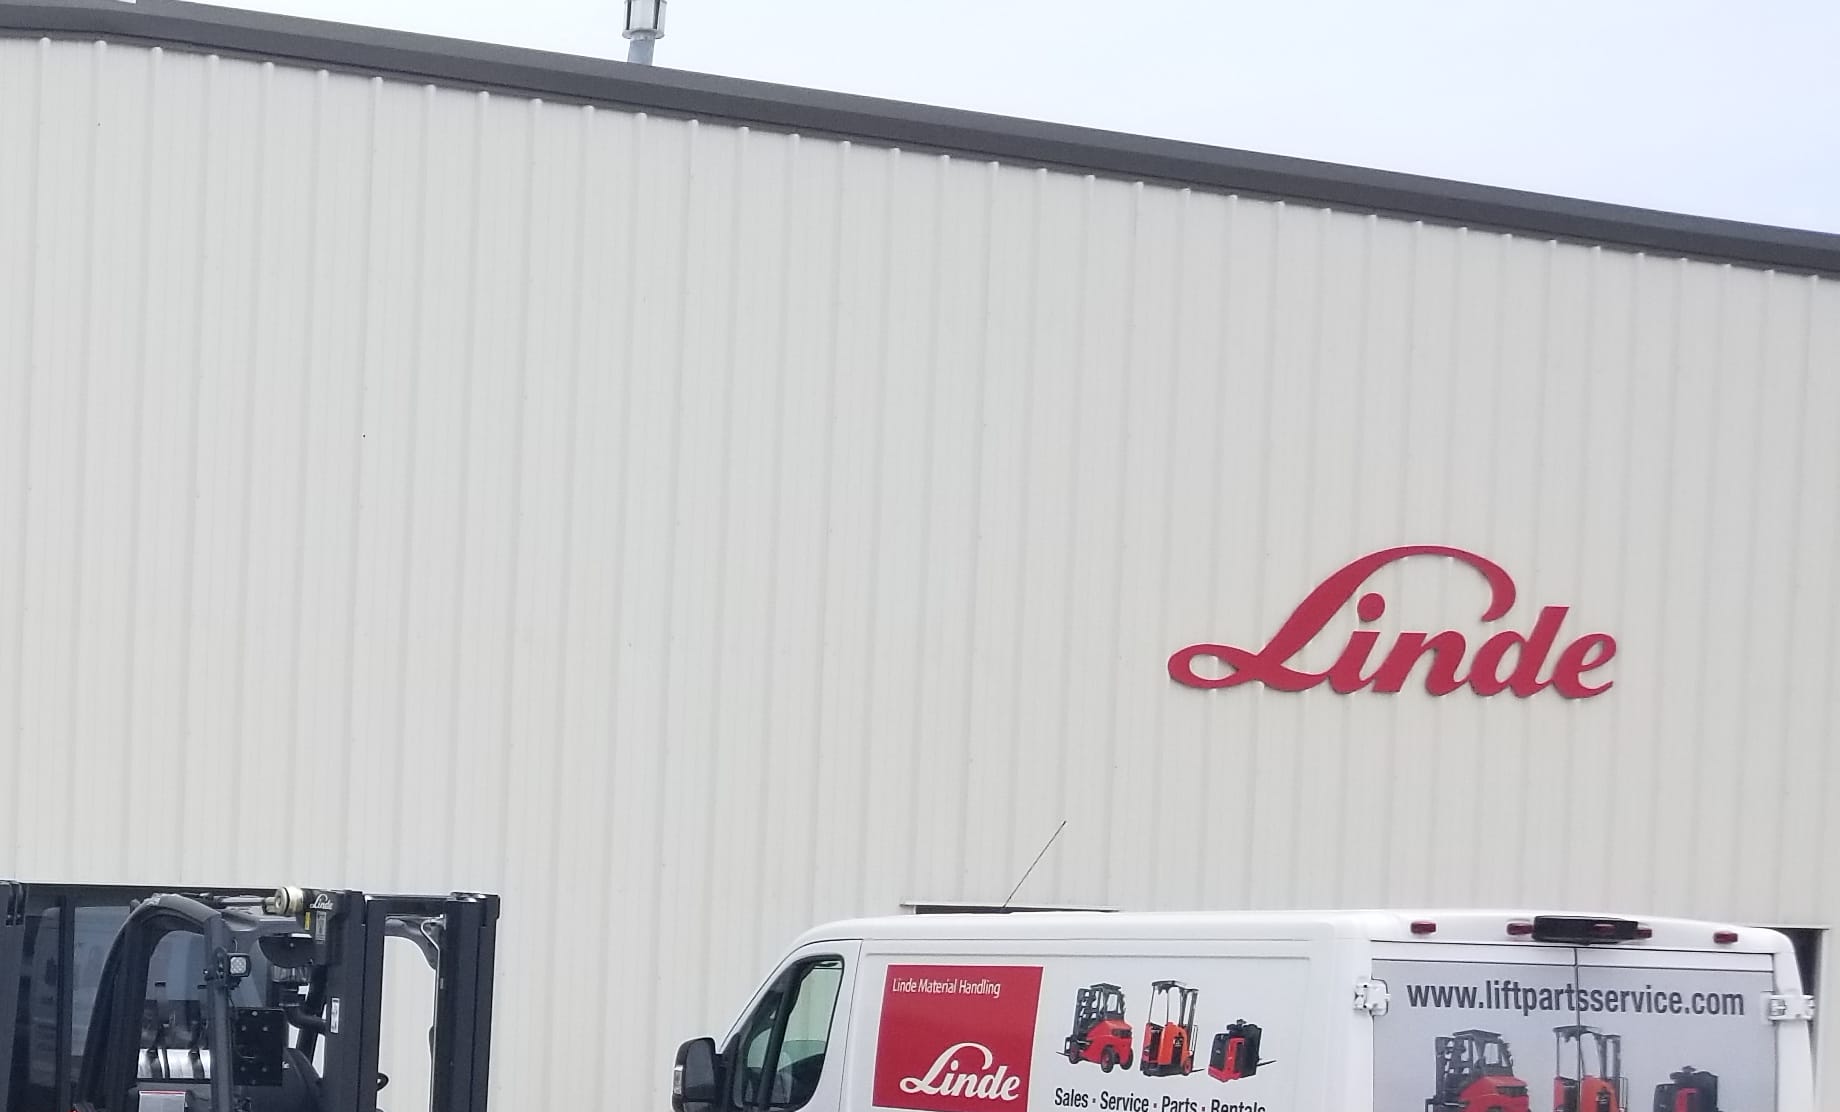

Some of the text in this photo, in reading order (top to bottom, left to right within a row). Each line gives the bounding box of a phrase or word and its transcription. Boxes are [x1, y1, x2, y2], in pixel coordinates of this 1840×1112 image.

[1167, 544, 1617, 699] Linde
[309, 893, 334, 910] Linde
[892, 978, 1001, 998] Linde Material Handling
[1406, 980, 1745, 1016] www.liftpartsservice.com
[899, 1042, 1021, 1101] Linde
[1054, 1087, 1089, 1108] Sales
[1099, 1090, 1149, 1112] Service
